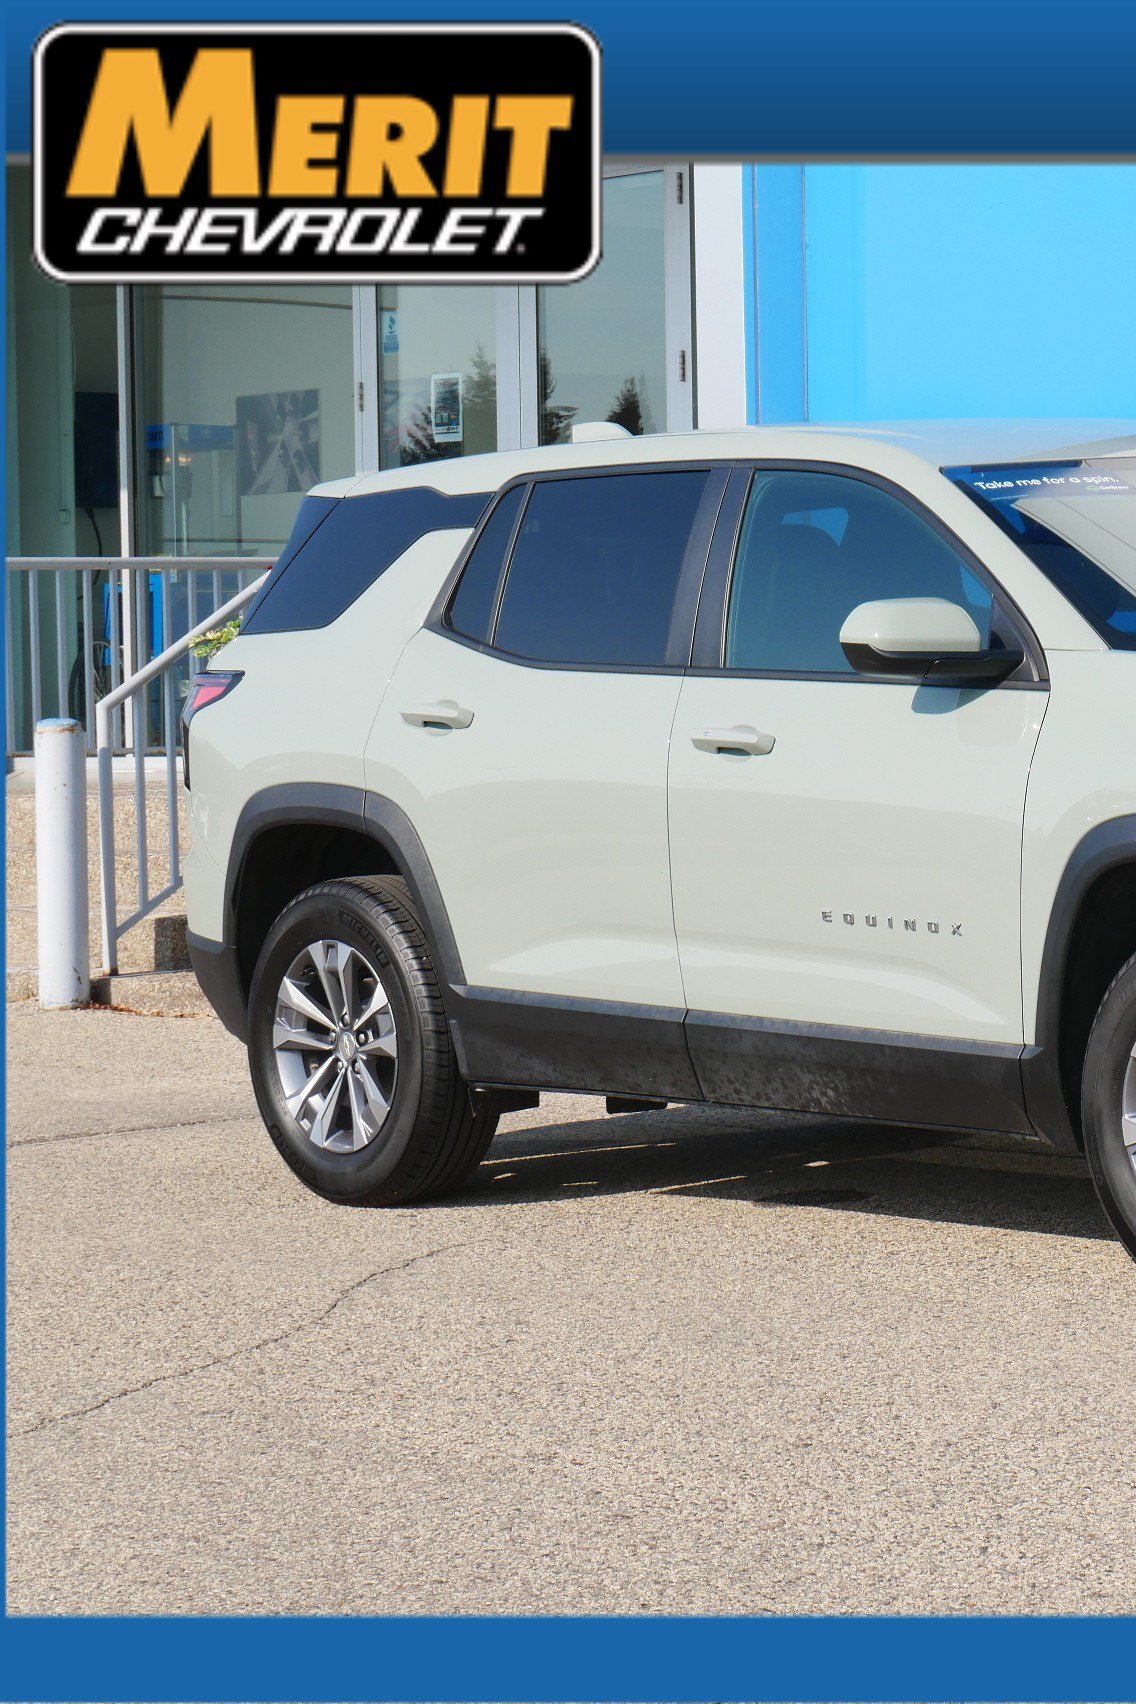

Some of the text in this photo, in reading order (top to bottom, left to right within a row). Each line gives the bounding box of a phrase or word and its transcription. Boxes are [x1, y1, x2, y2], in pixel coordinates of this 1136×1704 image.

[974, 480, 1014, 491] Take
[1016, 477, 1042, 487] me
[1043, 474, 1065, 486] for
[1083, 474, 1120, 486] spin.
[821, 910, 963, 937] EQUINOX
